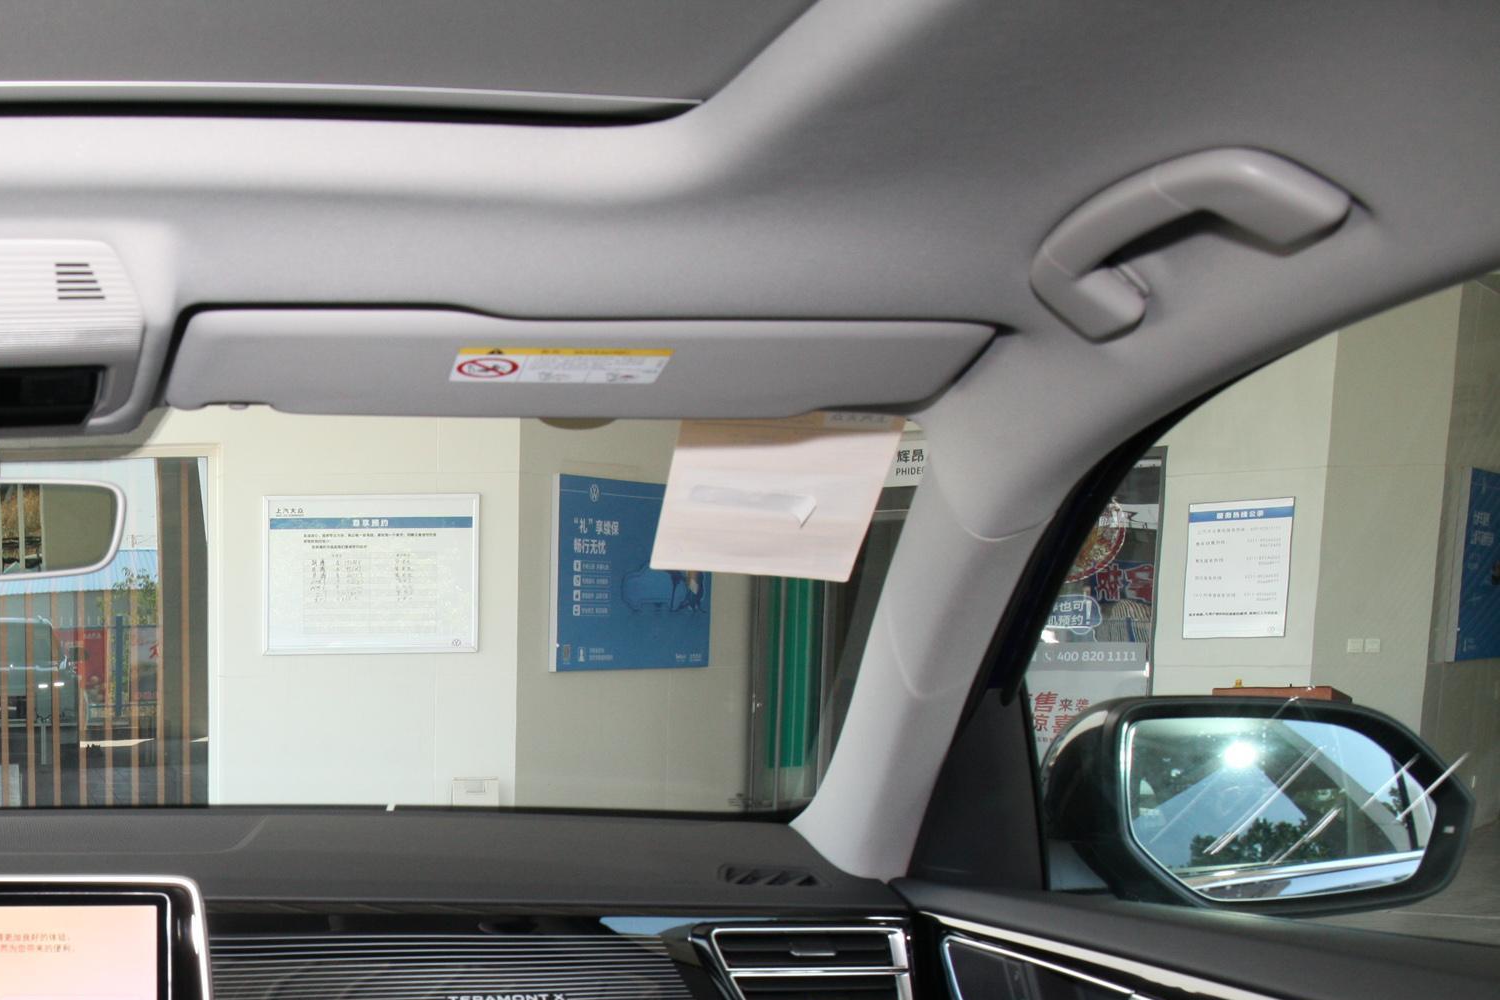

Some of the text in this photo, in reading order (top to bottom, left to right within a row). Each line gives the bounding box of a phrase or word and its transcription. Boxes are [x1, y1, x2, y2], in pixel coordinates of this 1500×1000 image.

[896, 449, 924, 463] 辉昂
[895, 466, 924, 476] PHIDE
[574, 538, 606, 555] 畅行无忧
[1057, 650, 1137, 661] 400 820 1111
[553, 993, 566, 1000] X
